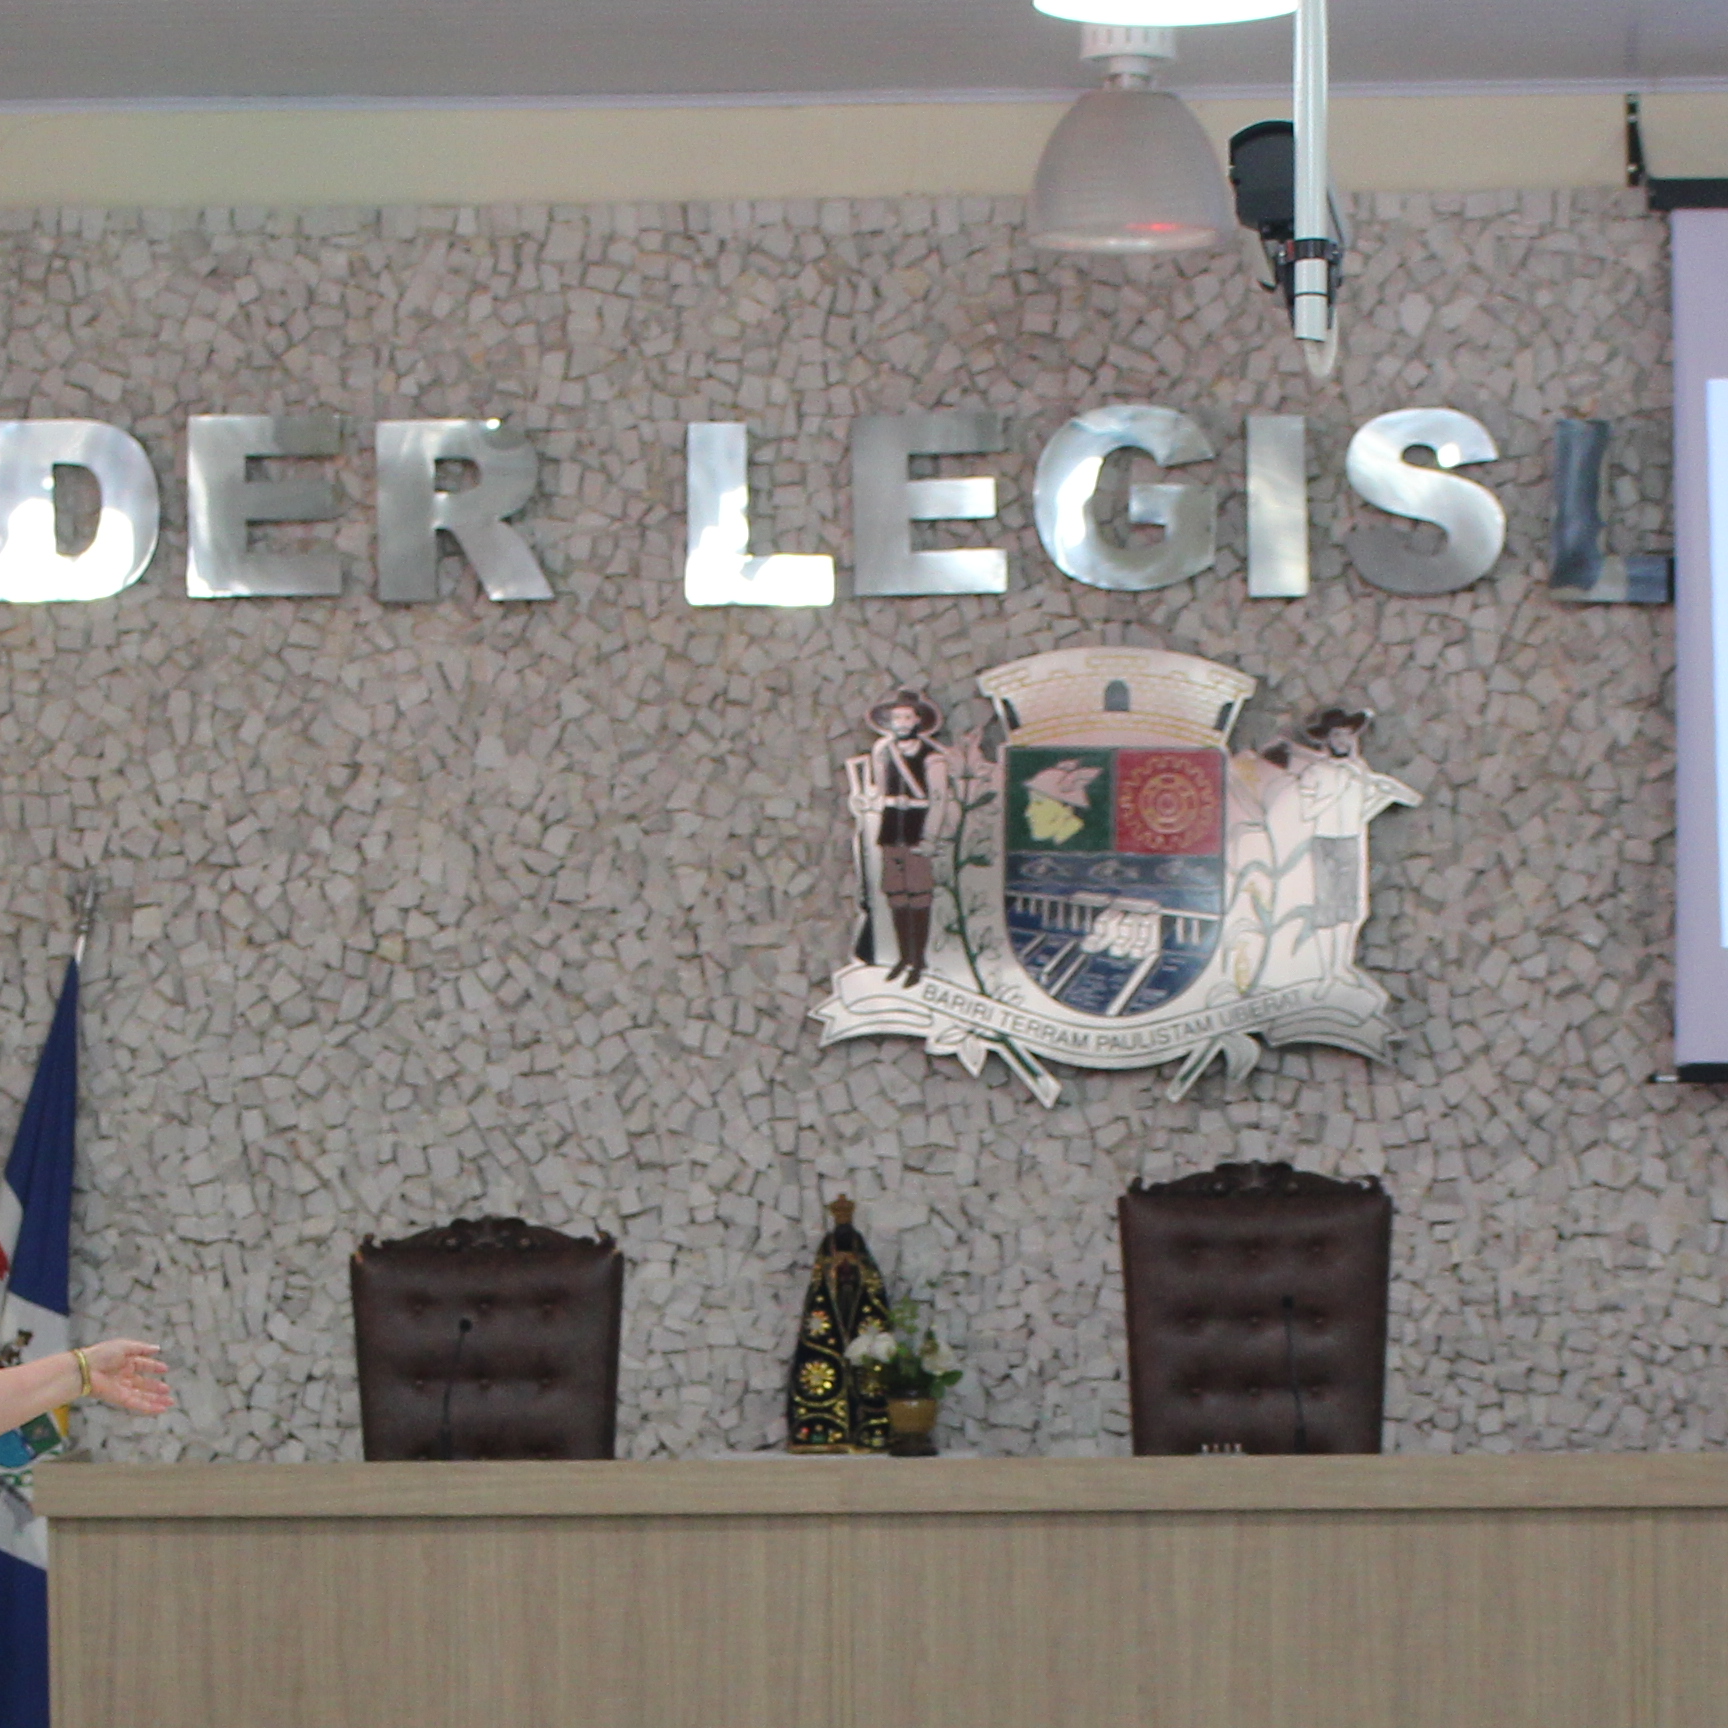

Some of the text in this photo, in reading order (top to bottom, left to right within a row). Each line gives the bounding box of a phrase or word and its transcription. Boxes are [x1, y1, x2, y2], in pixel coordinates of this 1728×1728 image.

[922, 983, 994, 1021] BARIRI
[999, 1012, 1090, 1049] TERRAM
[1095, 1014, 1215, 1051] PAULISTAM
